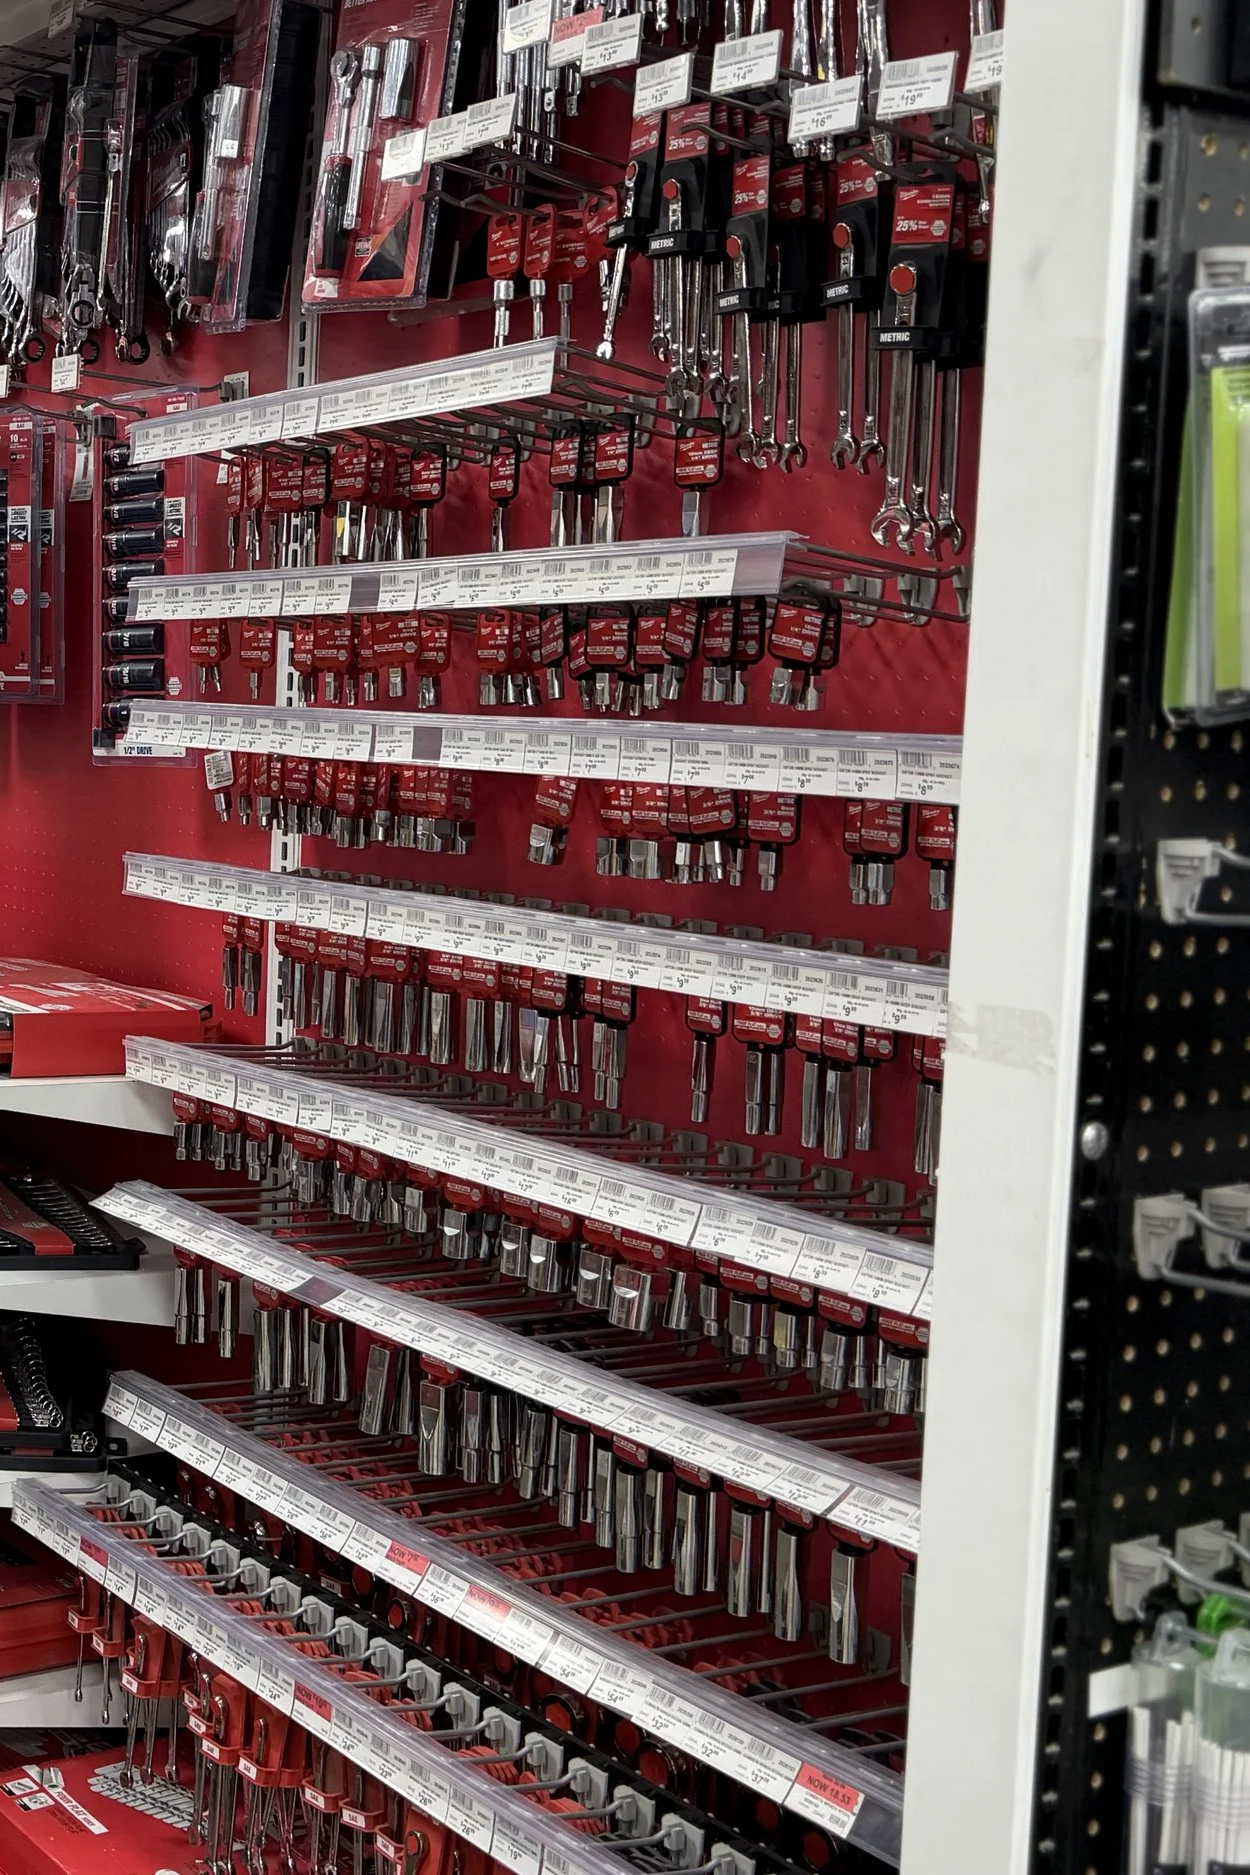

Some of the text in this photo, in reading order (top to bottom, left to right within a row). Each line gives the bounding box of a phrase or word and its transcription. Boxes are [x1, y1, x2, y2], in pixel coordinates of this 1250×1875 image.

[669, 139, 685, 150] 25%
[839, 180, 856, 194] 25%
[734, 193, 749, 204] 25%
[896, 220, 918, 231] 25%
[651, 237, 675, 249] METRIC
[826, 284, 849, 298] METRIC
[719, 294, 739, 308] METRIC
[880, 331, 910, 342] METRIC
[10, 434, 18, 443] 10
[123, 746, 153, 755] 1/2" DRIVE
[807, 1775, 829, 1793] NOW
[56, 1791, 73, 1804] FOUR
[68, 1804, 88, 1816] FLAT
[349, 1813, 358, 1823] SAE
